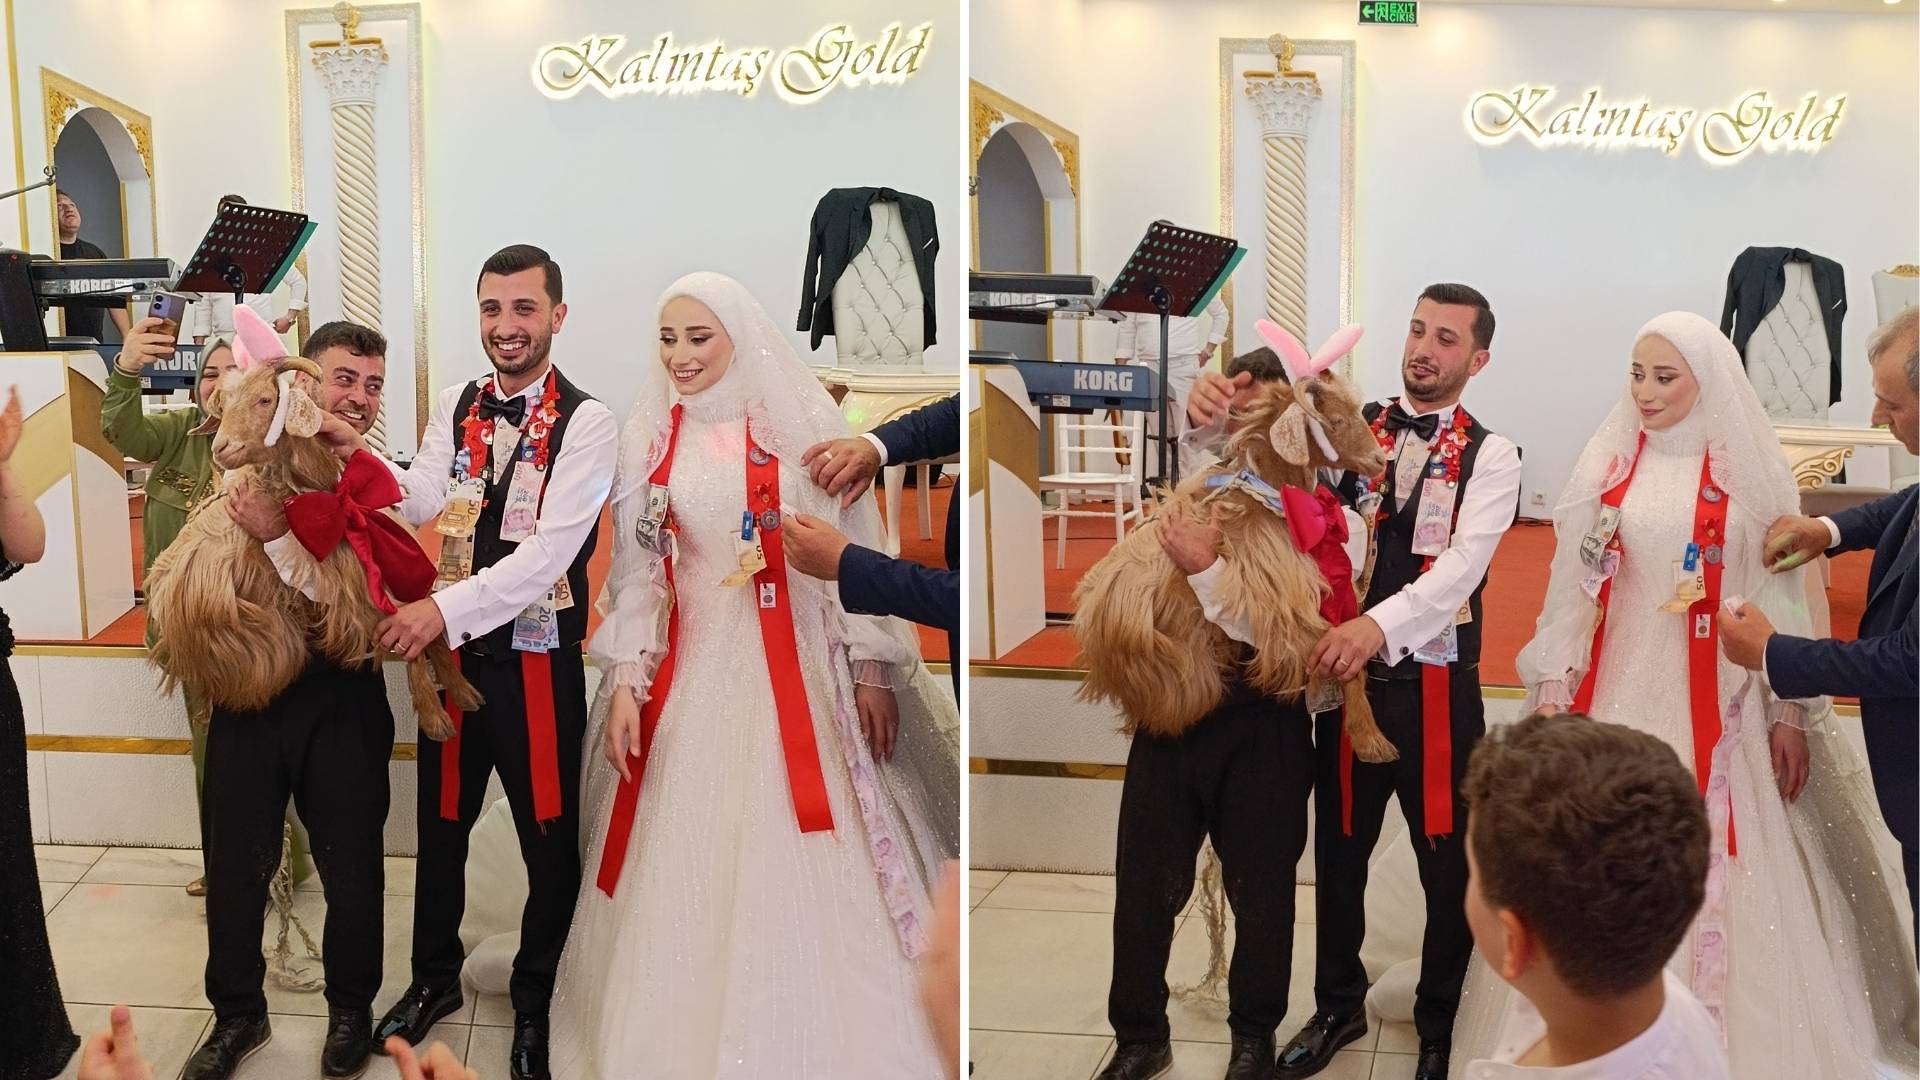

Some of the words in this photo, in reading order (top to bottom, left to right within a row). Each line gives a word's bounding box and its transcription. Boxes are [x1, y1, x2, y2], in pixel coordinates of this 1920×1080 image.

[1390, 3, 1415, 13] EXIT
[781, 25, 932, 95] Gold
[1702, 91, 1847, 157] Gold
[70, 279, 111, 294] KORG
[990, 292, 1033, 306] KORG
[153, 351, 202, 371] KOR
[1074, 369, 1133, 392] KORG
[468, 500, 480, 515] 50
[560, 583, 570, 600] 50
[1696, 576, 1704, 590] 50
[539, 606, 551, 623] 20
